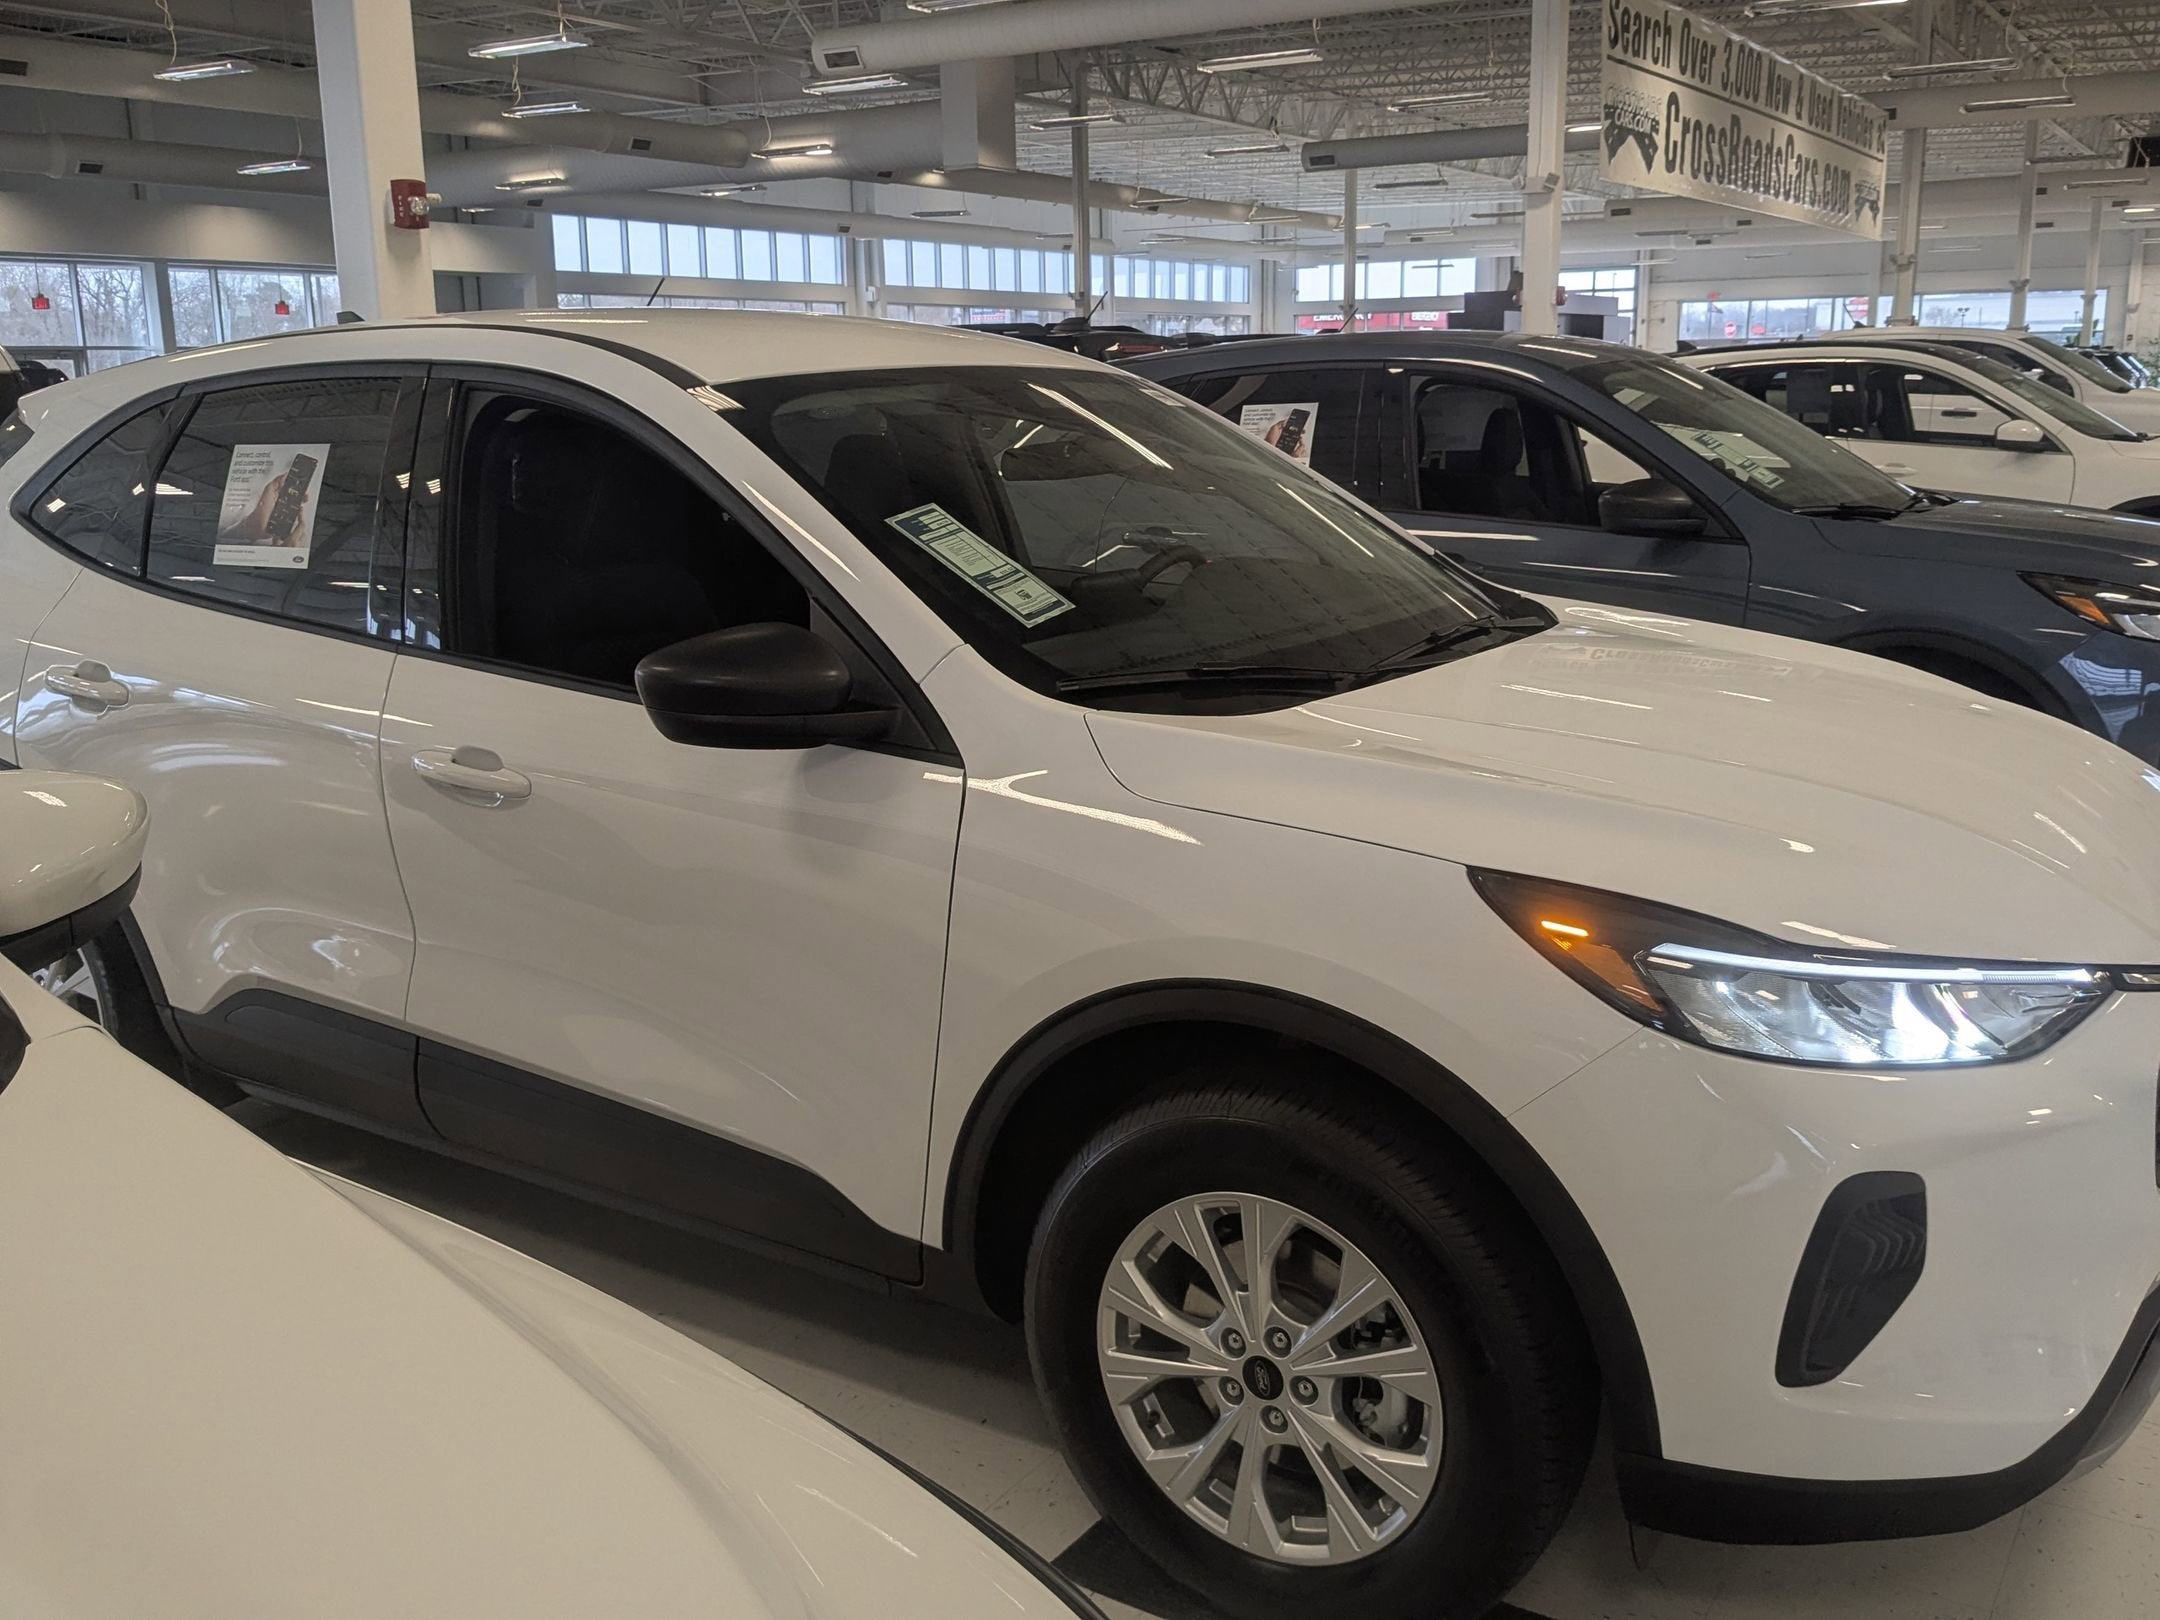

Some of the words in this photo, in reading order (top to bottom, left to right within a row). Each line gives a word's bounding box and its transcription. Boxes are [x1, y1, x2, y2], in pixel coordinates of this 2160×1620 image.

[1608, 0, 1673, 69] Search
[1679, 17, 1718, 86] Over
[1721, 37, 1763, 102] 3,000
[1765, 57, 1792, 115] New
[1795, 73, 1804, 120] &
[1808, 79, 1835, 132] Used
[1836, 92, 1874, 150] Vehicles
[1664, 91, 1851, 215] CrossRoadsCars.com
